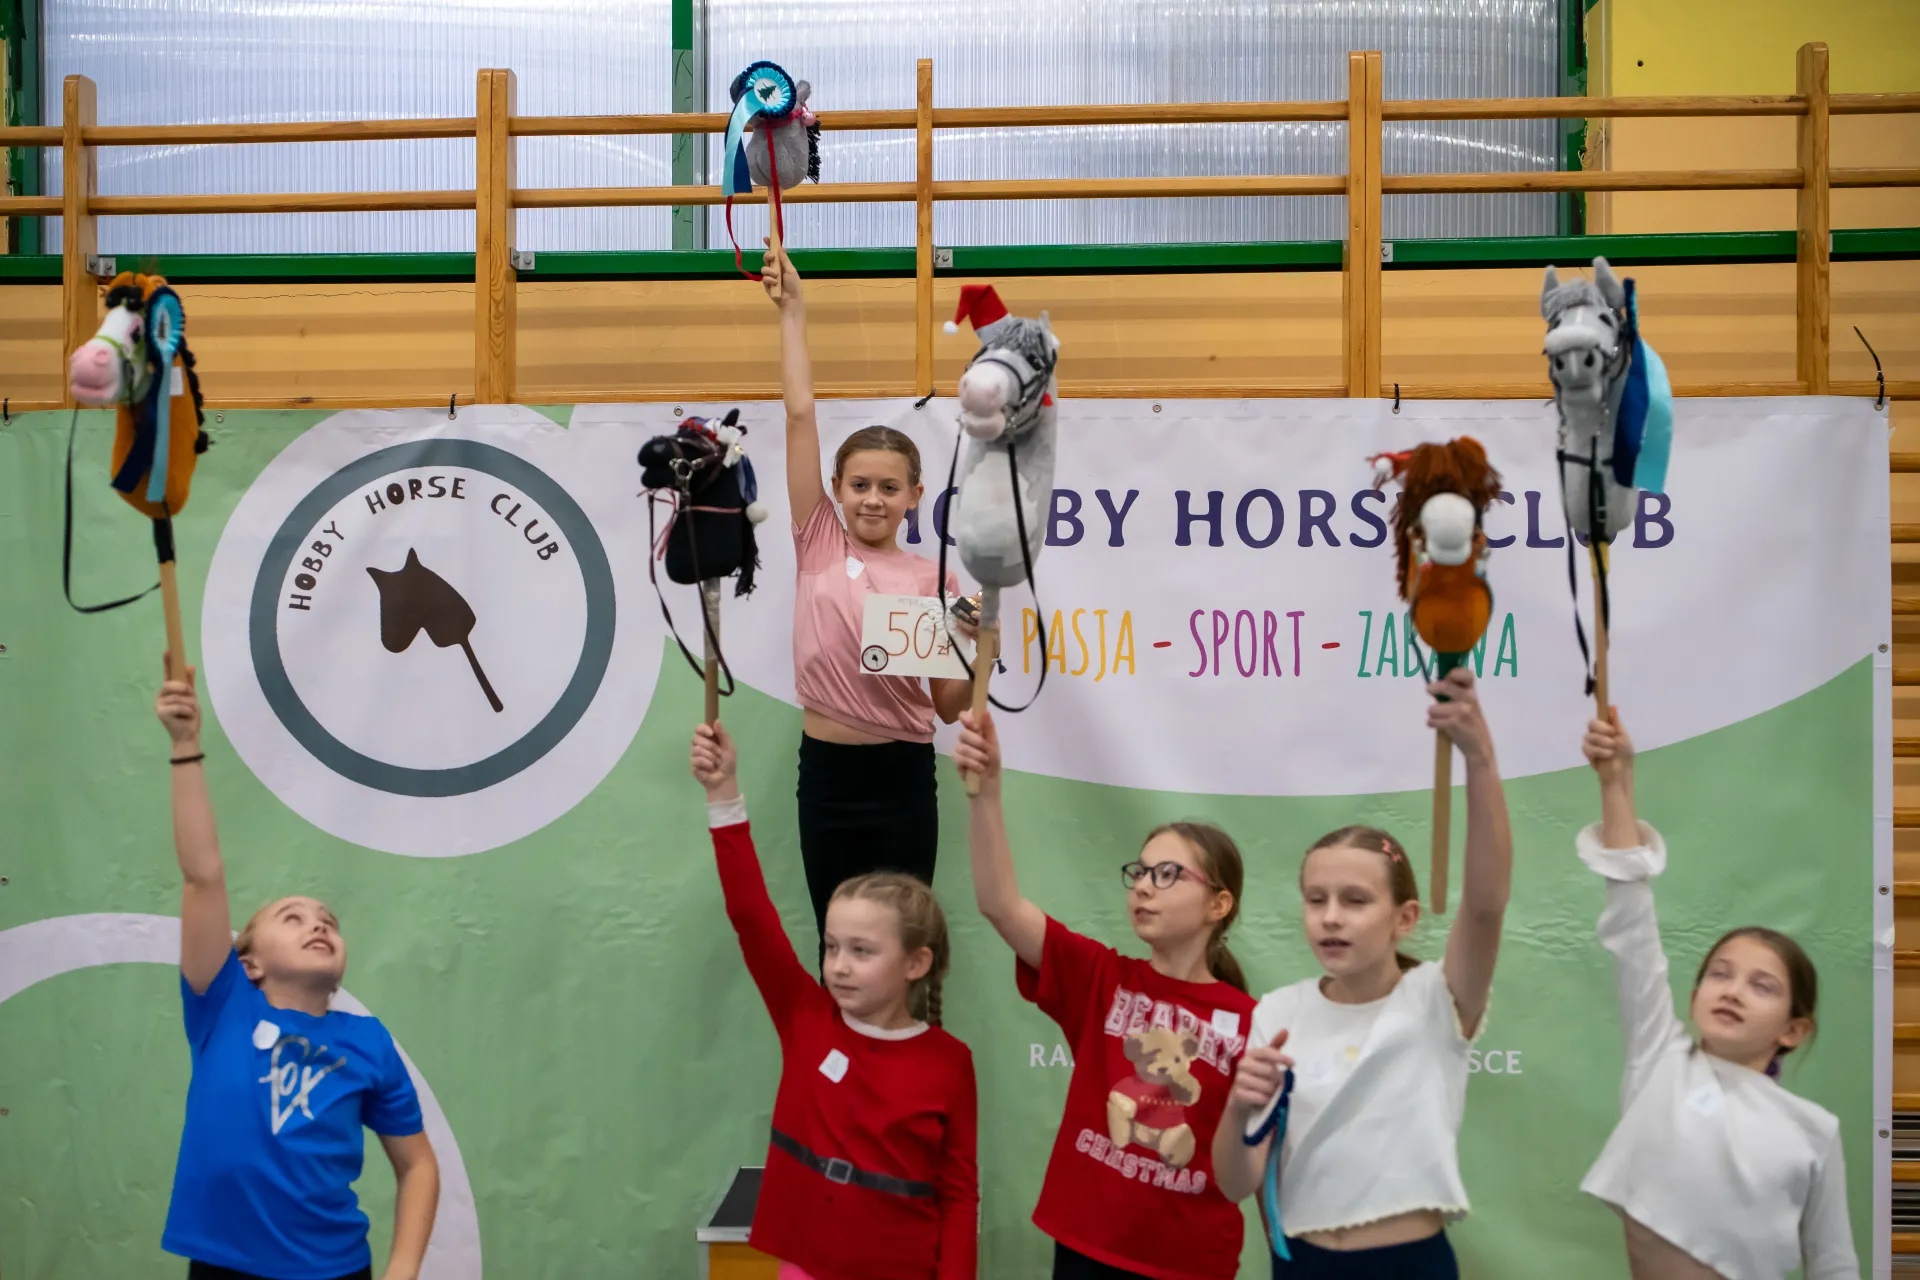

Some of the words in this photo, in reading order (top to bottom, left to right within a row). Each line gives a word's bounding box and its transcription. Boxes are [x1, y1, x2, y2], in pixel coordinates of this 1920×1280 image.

[288, 520, 345, 611] HOBBY
[365, 475, 466, 515] HORSE
[490, 493, 560, 561] CLUB
[1174, 488, 1404, 549] HORS
[886, 611, 937, 660] 50
[1021, 607, 1136, 683] PASJA
[1188, 609, 1305, 678] SPORT
